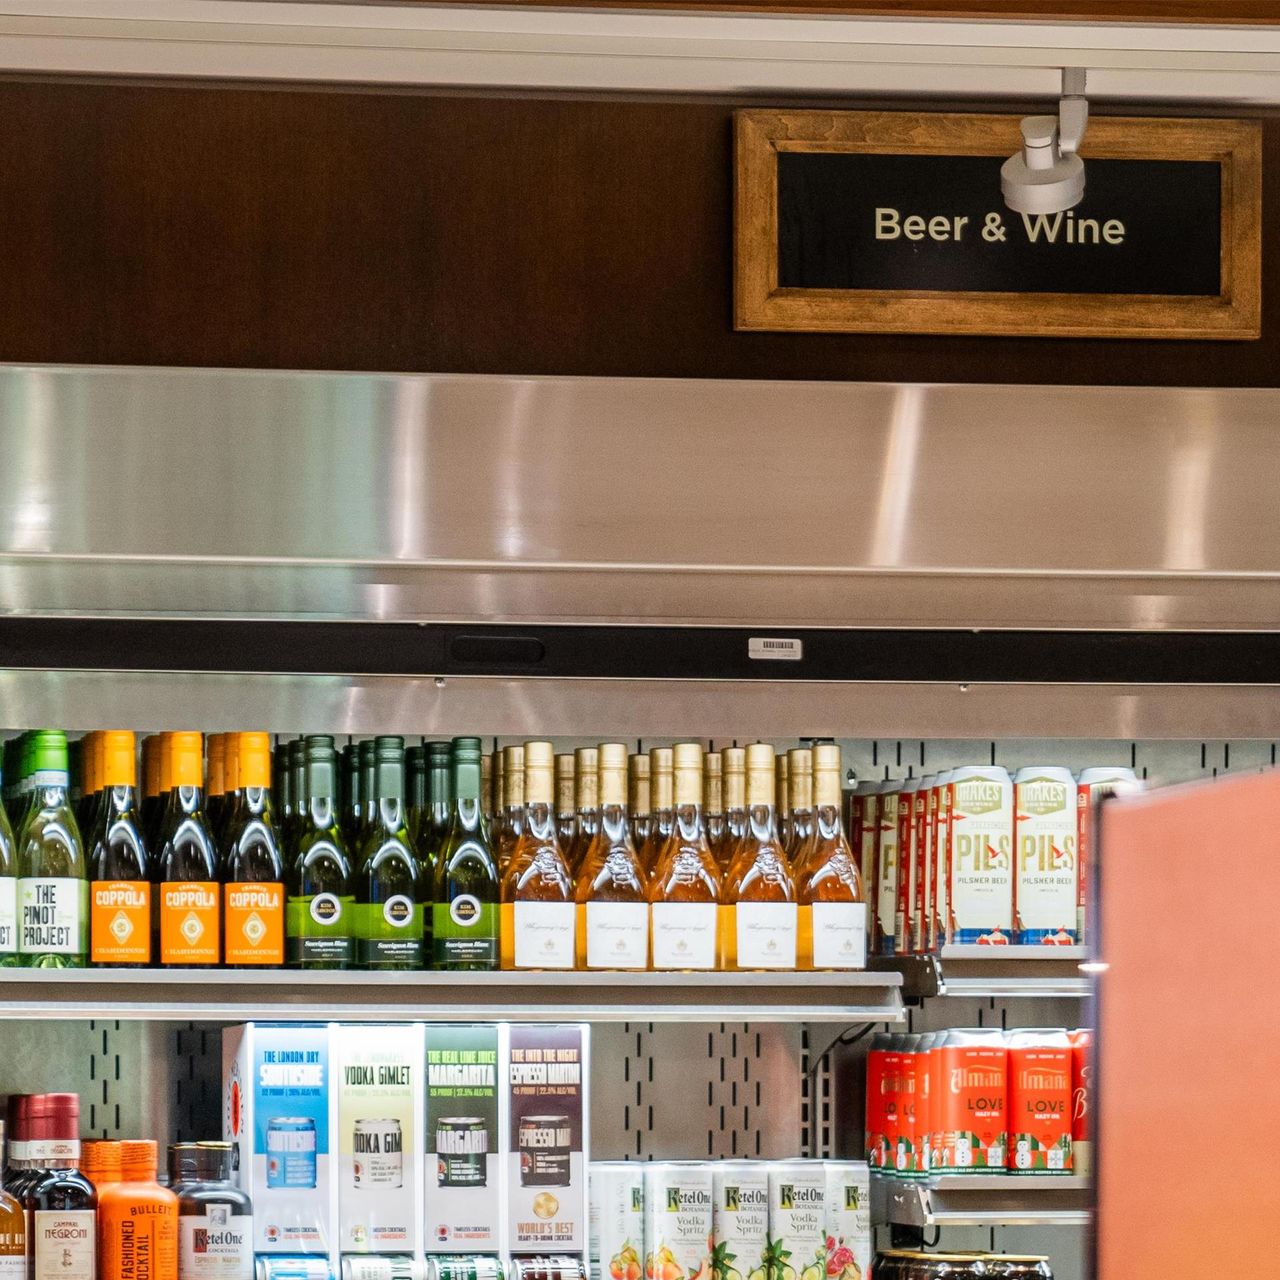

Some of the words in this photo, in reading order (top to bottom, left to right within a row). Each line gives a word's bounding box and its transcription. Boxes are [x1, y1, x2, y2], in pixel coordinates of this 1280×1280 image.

[874, 207, 968, 242] Beer
[981, 212, 1006, 242] &
[1022, 211, 1126, 244] Wine
[956, 834, 1010, 872] PILS
[1021, 834, 1074, 872] PILS
[1022, 876, 1054, 884] PILSNER
[35, 885, 56, 904] THE
[95, 890, 146, 906] COPPOLA
[166, 891, 216, 907] COPPOLA
[230, 892, 279, 908] COPPOLA
[23, 905, 56, 925] PINOT
[23, 927, 70, 946] PROJECT
[264, 1050, 278, 1063] THE
[279, 1050, 304, 1063] LONDON
[344, 1065, 375, 1086] VODKA
[967, 1098, 1003, 1110] LOVE
[1027, 1100, 1065, 1112] LOVE
[667, 1188, 696, 1209] Ketel
[725, 1187, 755, 1207] Ketel
[781, 1185, 811, 1206] Ketel
[129, 1204, 173, 1216] BULLEIT
[790, 1213, 818, 1223] Vodka
[517, 1222, 553, 1234] WORLD'S
[676, 1216, 705, 1226] Vodka
[735, 1215, 763, 1225] Vodka
[790, 1222, 818, 1233] Spritz
[44, 1228, 88, 1239] NEGRONI
[676, 1225, 705, 1236] Spritz
[735, 1225, 763, 1236] Spritz
[194, 1230, 224, 1248] Ketel
[225, 1231, 243, 1245] One
[121, 1219, 134, 1280] FASHIONED
